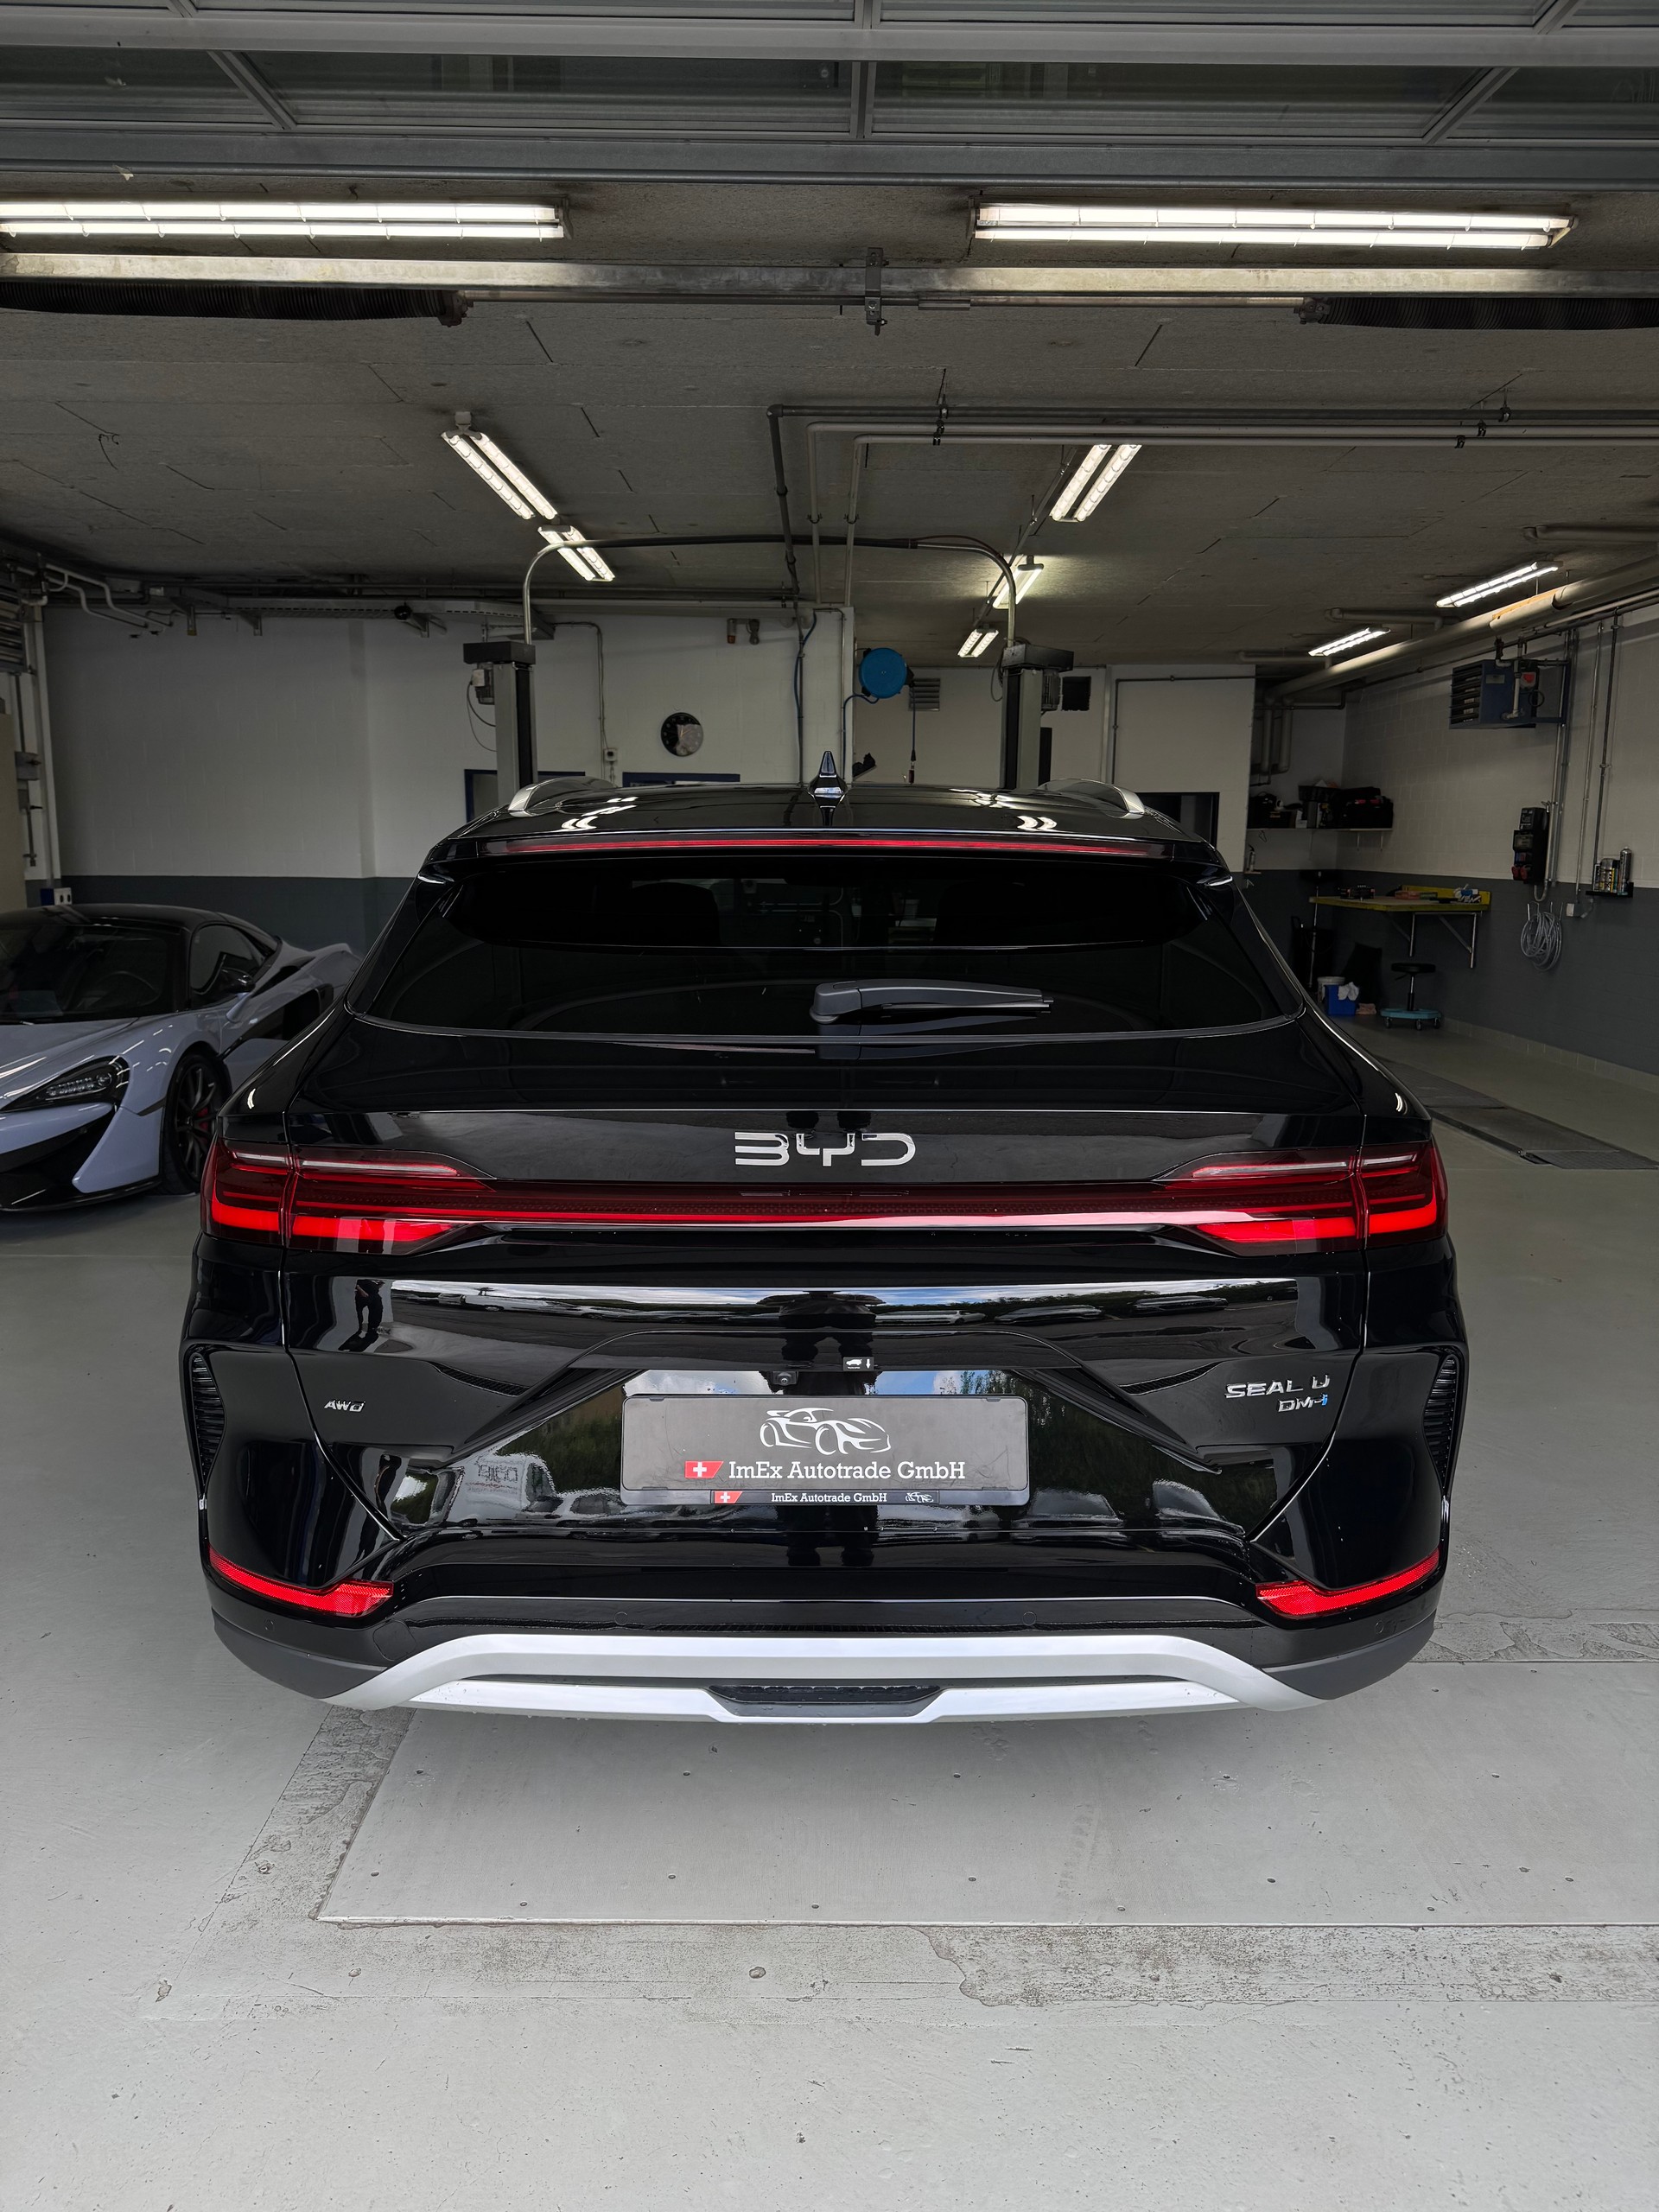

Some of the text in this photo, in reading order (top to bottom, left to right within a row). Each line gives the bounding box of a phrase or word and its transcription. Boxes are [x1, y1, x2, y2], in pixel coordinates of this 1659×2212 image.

[734, 1131, 916, 1166] BYD
[1225, 1375, 1331, 1399] SEAL U
[324, 1400, 366, 1412] AWD
[1278, 1394, 1328, 1412] DM-i
[728, 1461, 966, 1479] ImEx Autotrade GmbH
[771, 1492, 887, 1503] ImEx Autotrade GmbH
